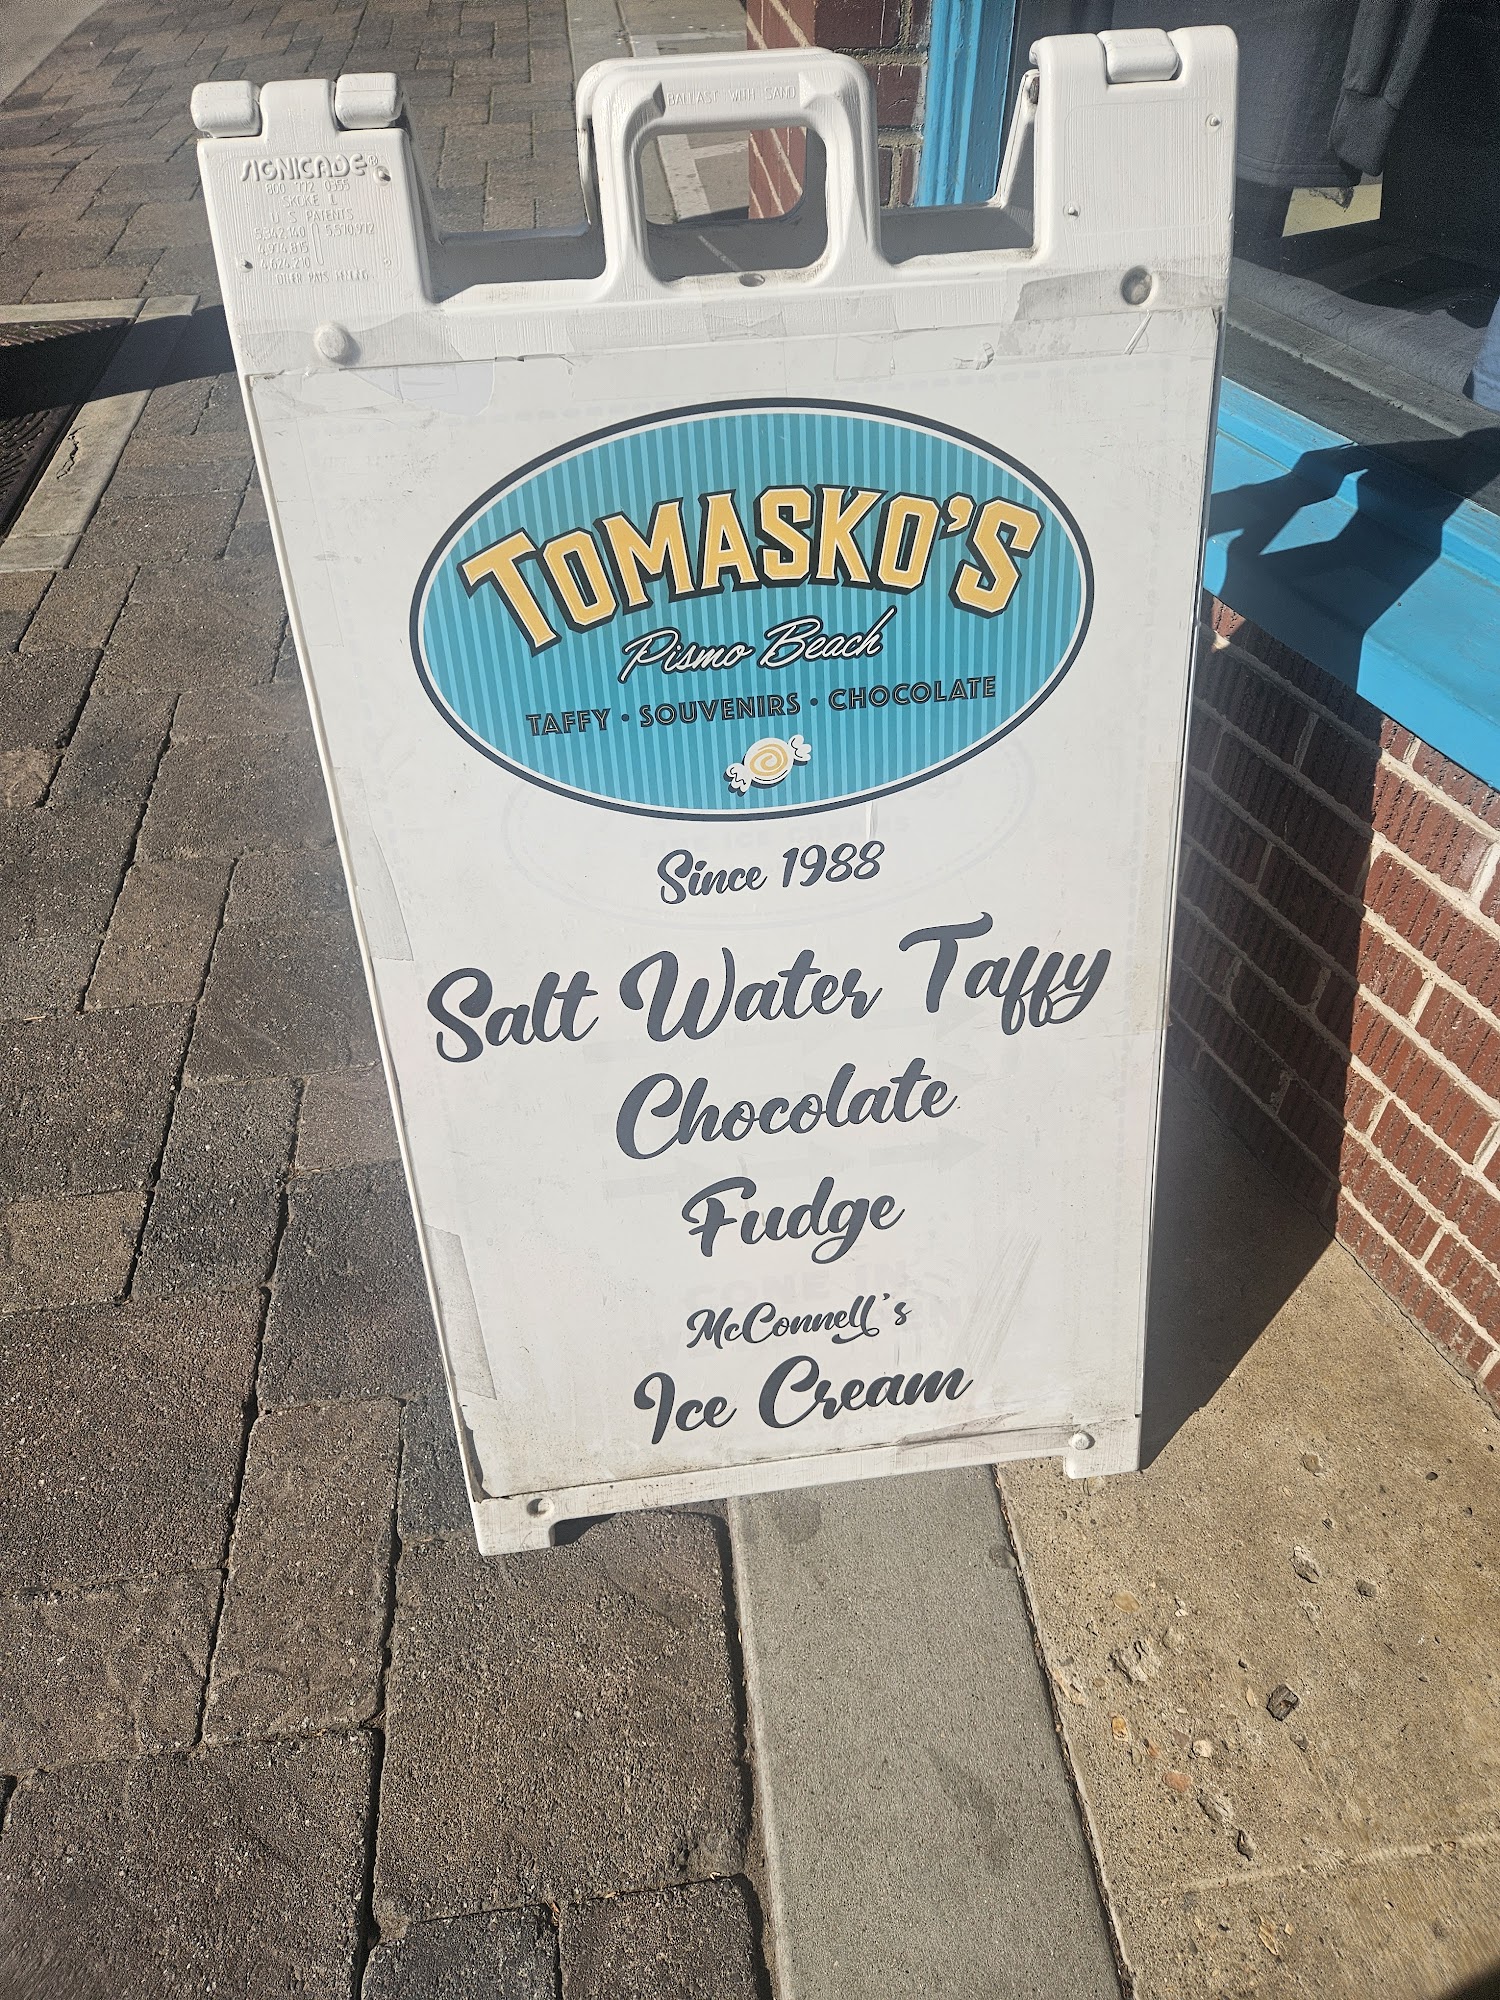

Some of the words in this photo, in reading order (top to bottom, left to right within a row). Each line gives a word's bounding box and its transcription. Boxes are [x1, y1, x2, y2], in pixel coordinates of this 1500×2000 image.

[666, 90, 719, 107] BALLAST
[728, 89, 756, 102] WITH
[764, 86, 796, 101] SAND
[265, 182, 286, 195] 800
[305, 208, 354, 222] PATENTS
[616, 625, 754, 684] Pismo
[755, 605, 897, 671] Beach
[526, 707, 611, 737] TAFFY
[639, 692, 802, 727] SOUVENIRS
[827, 675, 998, 711] CHOCOLATE
[657, 848, 767, 905] Since
[782, 840, 885, 888] 1988
[427, 967, 599, 1063] Salt
[619, 946, 882, 1043] Water
[899, 911, 1112, 1036] Taffy
[615, 1057, 959, 1160] Chocolate
[681, 1176, 906, 1265] Fudge
[633, 1371, 738, 1445] Ice
[758, 1355, 974, 1429] Cream
